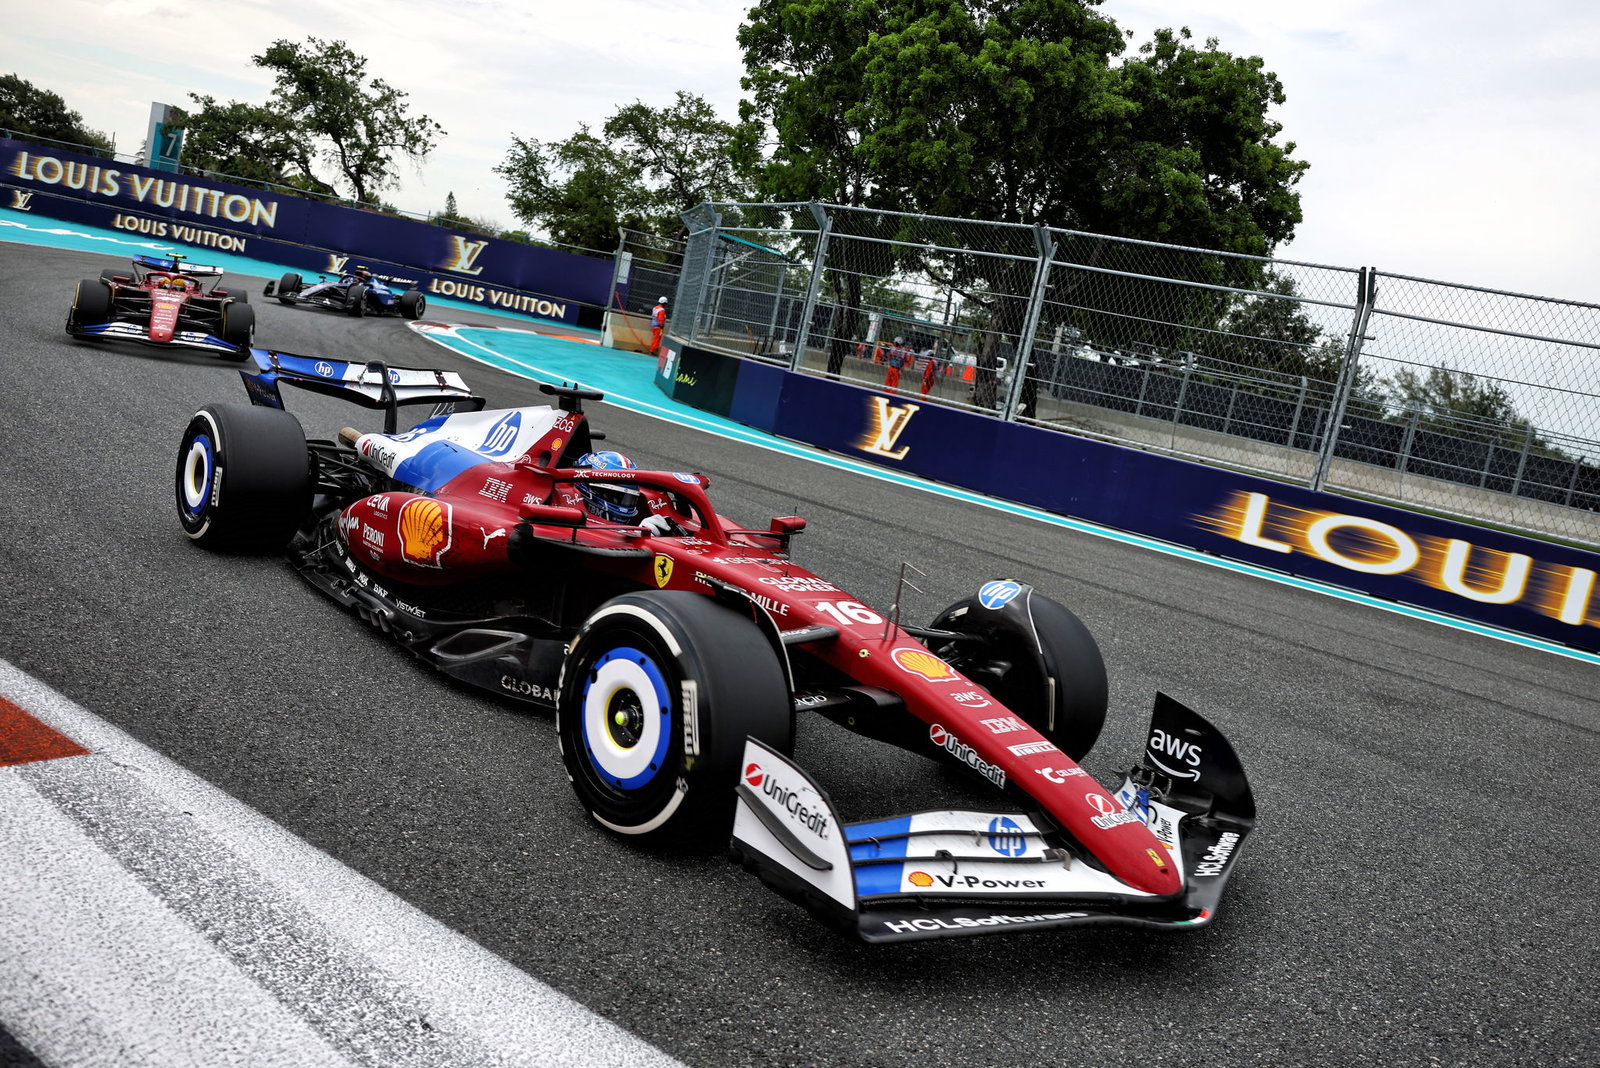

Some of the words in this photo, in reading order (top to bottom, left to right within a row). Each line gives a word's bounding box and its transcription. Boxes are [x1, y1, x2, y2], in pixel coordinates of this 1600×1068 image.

[165, 133, 177, 156] 7
[18, 151, 121, 197] LOUIS
[132, 174, 278, 228] VUITTON
[116, 213, 168, 237] LOUIS
[171, 225, 246, 252] VUITTON
[432, 278, 485, 302] LOUIS
[488, 289, 566, 319] VUITTON
[316, 362, 332, 377] hp
[477, 411, 519, 454] hp
[553, 416, 574, 433] ZCG
[369, 440, 397, 470] UniCredit
[592, 471, 636, 479] TECHNOLOGY
[366, 494, 391, 512] CEVA
[478, 477, 514, 504] IBM
[522, 492, 543, 506] aws
[362, 522, 385, 547] PERONI
[1238, 491, 1597, 626] LOUI
[757, 576, 833, 586] GLOBAL
[776, 583, 841, 593] POKER
[749, 592, 791, 617] MILLE
[981, 582, 1016, 608] hp
[815, 600, 883, 625] 16
[950, 691, 985, 703] aws
[681, 679, 700, 756] PIRELLI
[979, 717, 1028, 734] IBM
[1007, 740, 1059, 757] PIRELLI
[1150, 728, 1203, 767] aws
[944, 731, 1007, 790] UniCredit
[763, 773, 828, 840] UniCredit
[997, 817, 1026, 857] hp
[1156, 818, 1173, 843] V-Power
[1194, 831, 1241, 877] HCLSoftware
[936, 872, 1046, 891] V-Power
[884, 911, 1088, 933] HCLSoftware
